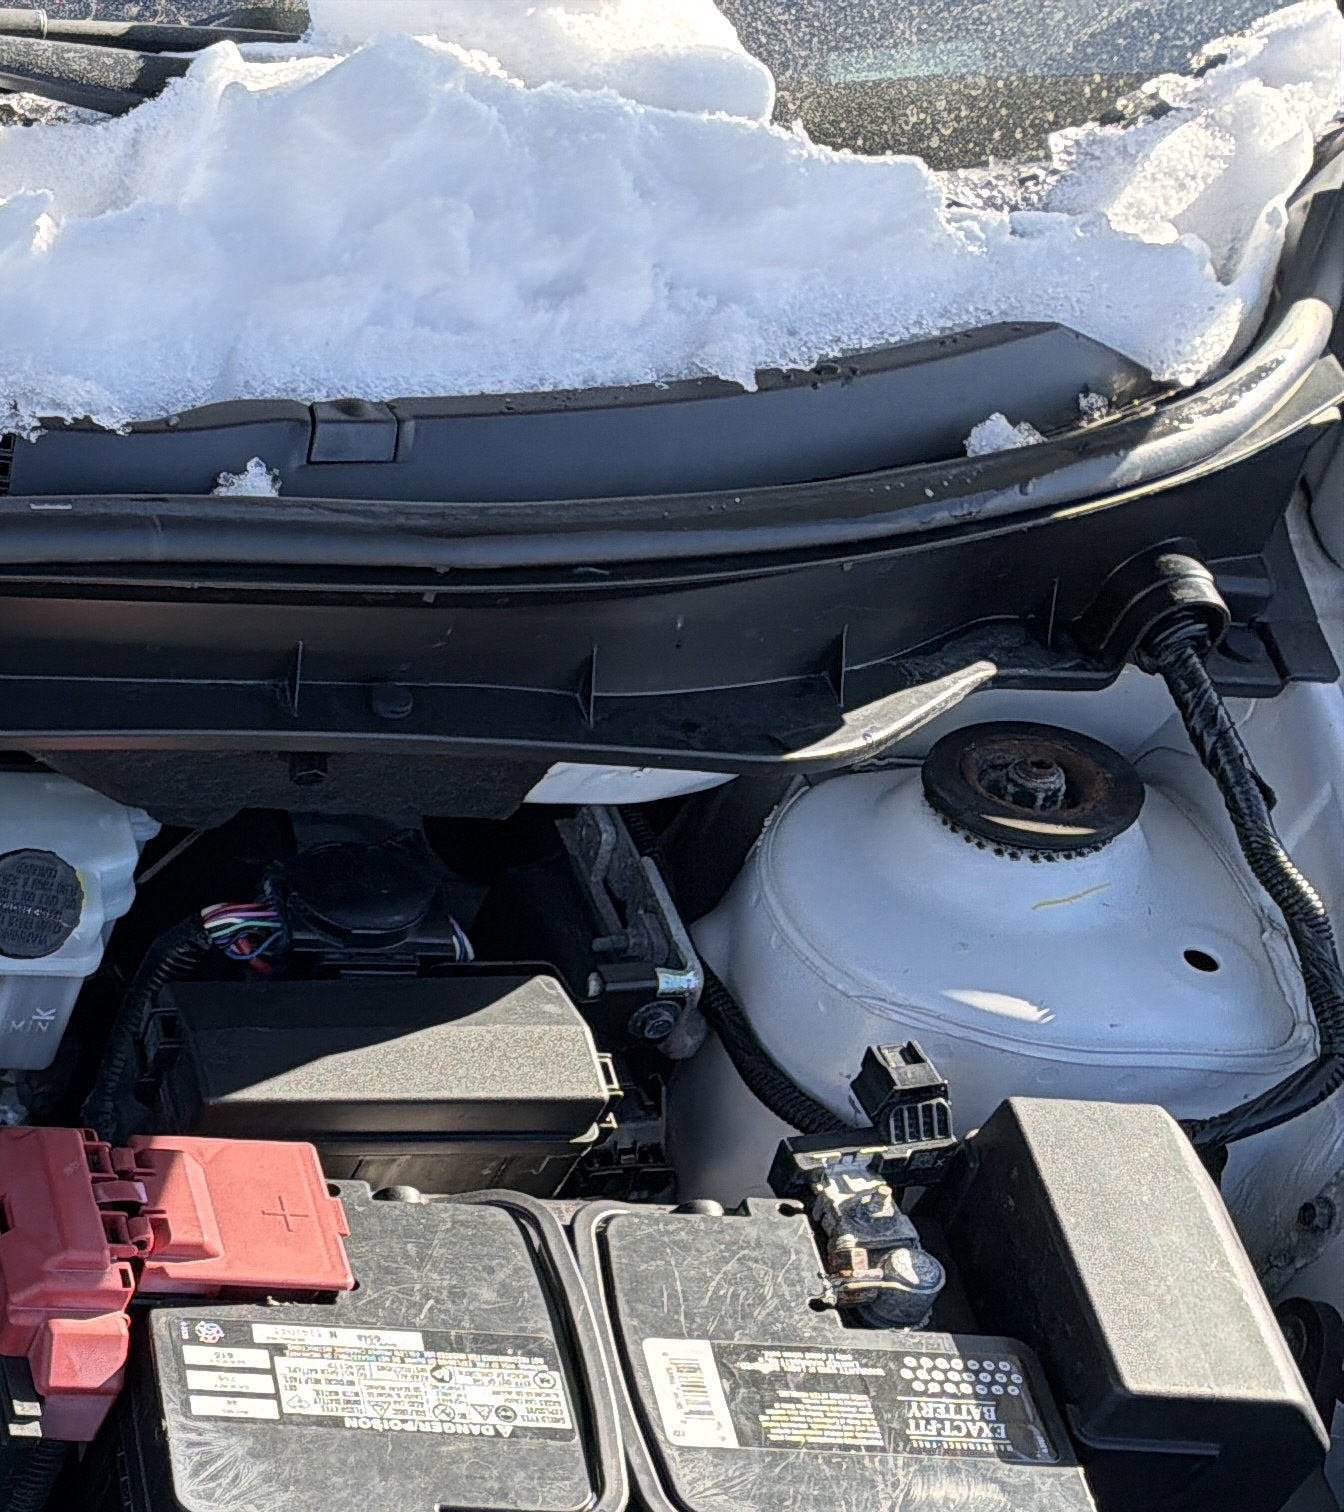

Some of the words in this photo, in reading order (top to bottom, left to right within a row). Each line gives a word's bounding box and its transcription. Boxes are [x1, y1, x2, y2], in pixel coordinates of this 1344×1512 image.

[906, 1401, 997, 1421] BATTERY
[344, 1416, 495, 1436] DANGER/POISON
[906, 1418, 1007, 1439] EXACT-FIT
